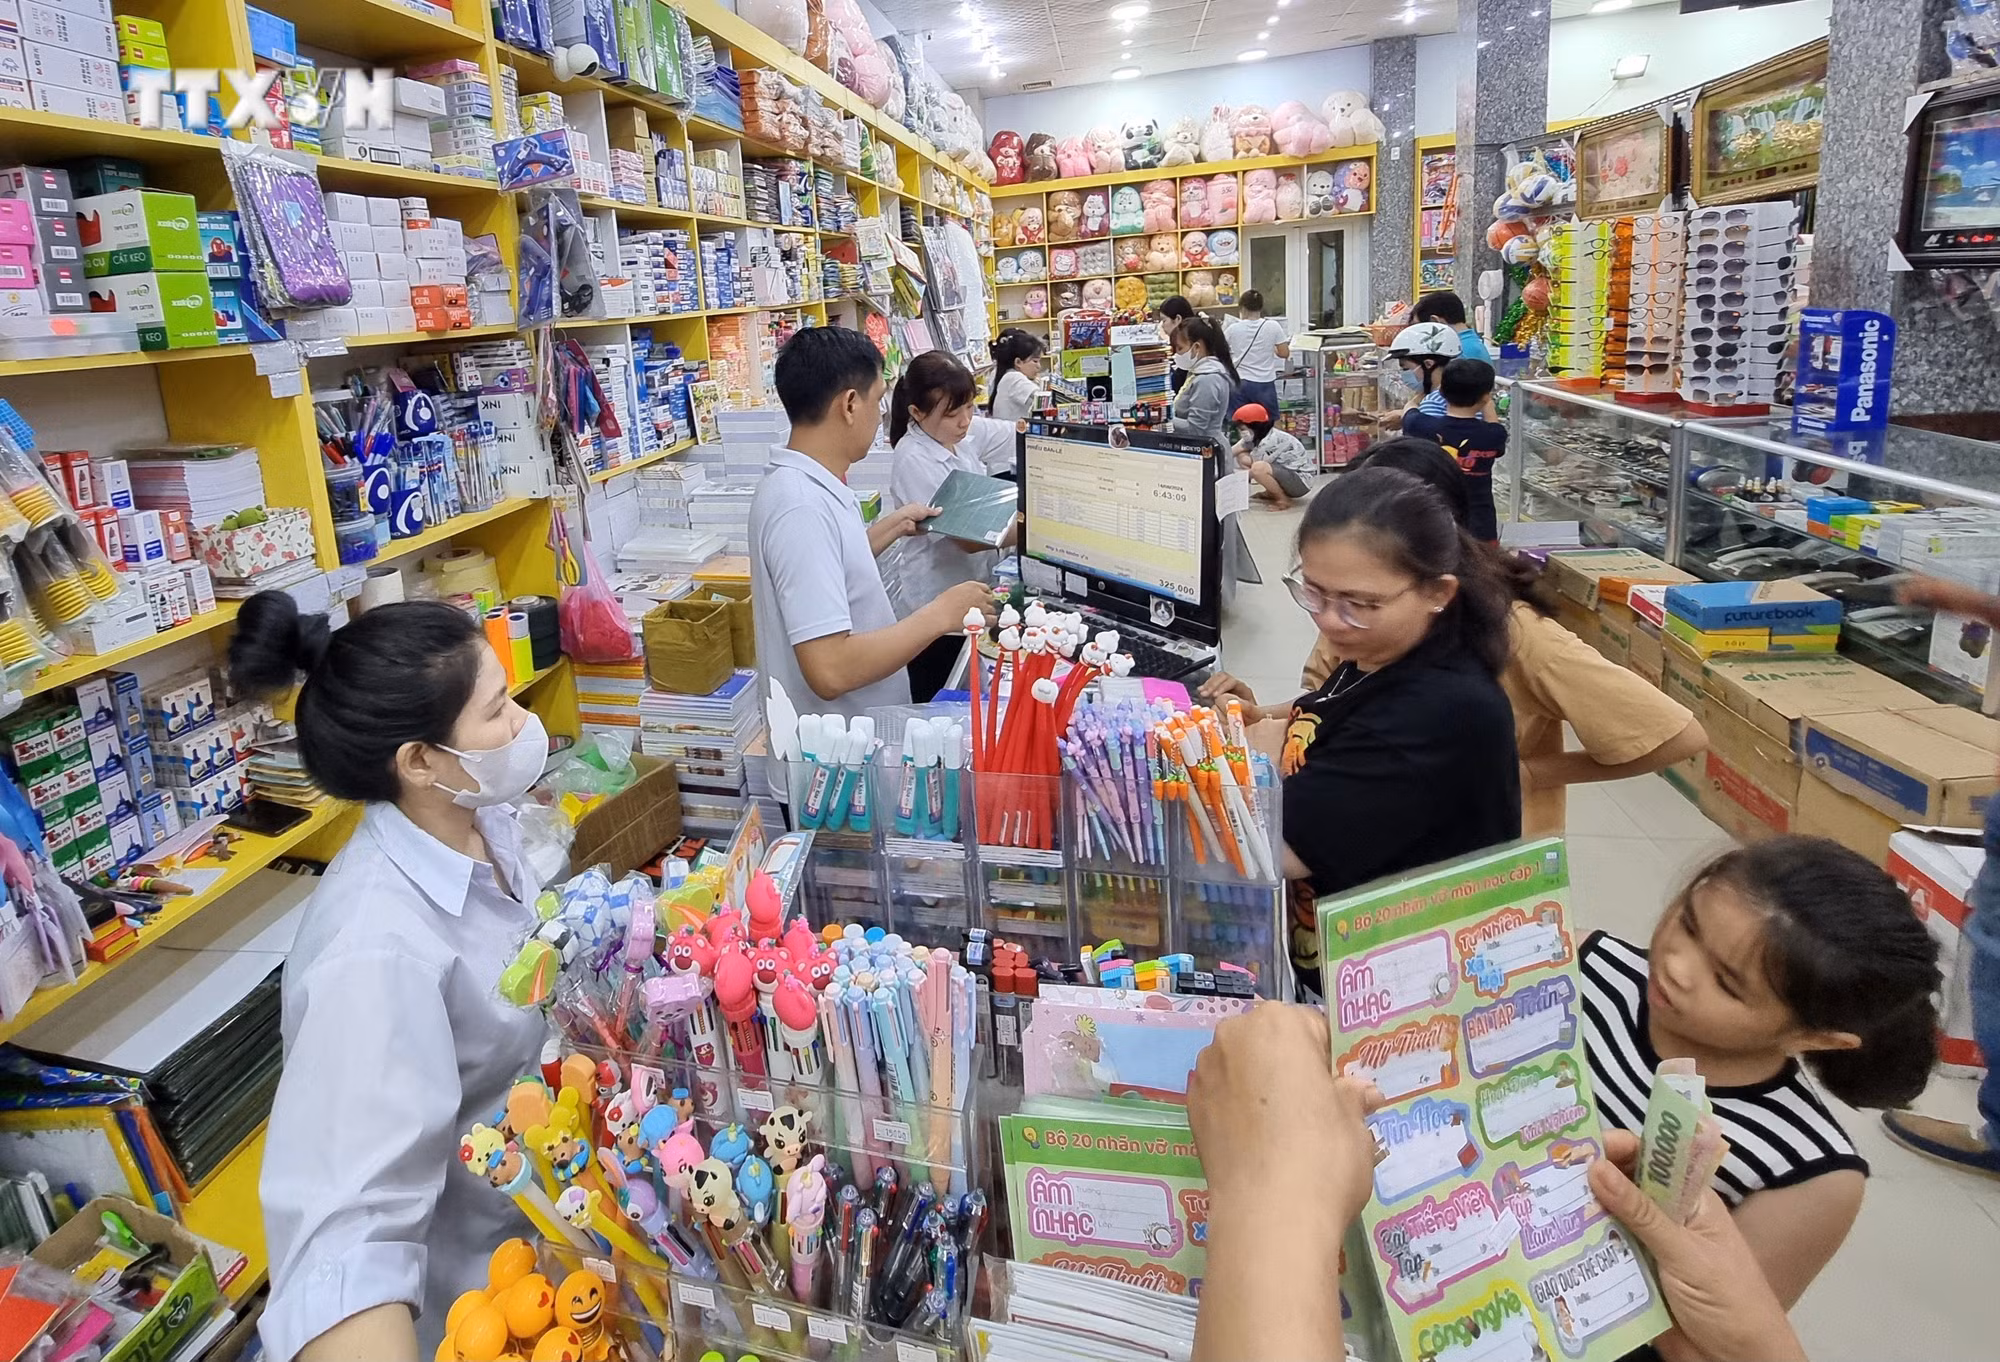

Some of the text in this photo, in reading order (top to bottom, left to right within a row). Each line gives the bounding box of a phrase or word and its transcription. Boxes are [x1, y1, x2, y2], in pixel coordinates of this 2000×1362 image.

[1850, 319, 1880, 422] Panasonic
[482, 400, 501, 410] INK
[498, 434, 516, 443] INK
[502, 466, 520, 475] INK
[1153, 489, 1187, 502] 6:43:09
[1724, 608, 1816, 625] futurebook
[1354, 911, 1372, 931] Bộ
[1375, 907, 1390, 924] 20
[1509, 863, 1532, 883] cấp
[1481, 914, 1523, 942] Nhiên
[1045, 1130, 1068, 1150] Bộ
[1072, 1133, 1092, 1148] 20
[1096, 1135, 1141, 1153] nhãn
[1380, 1116, 1413, 1147] Tin
[1408, 1187, 1487, 1239] Tiếng Việt
[1395, 1253, 1425, 1282] Tập
[1418, 1288, 1523, 1354] Công nghệ
